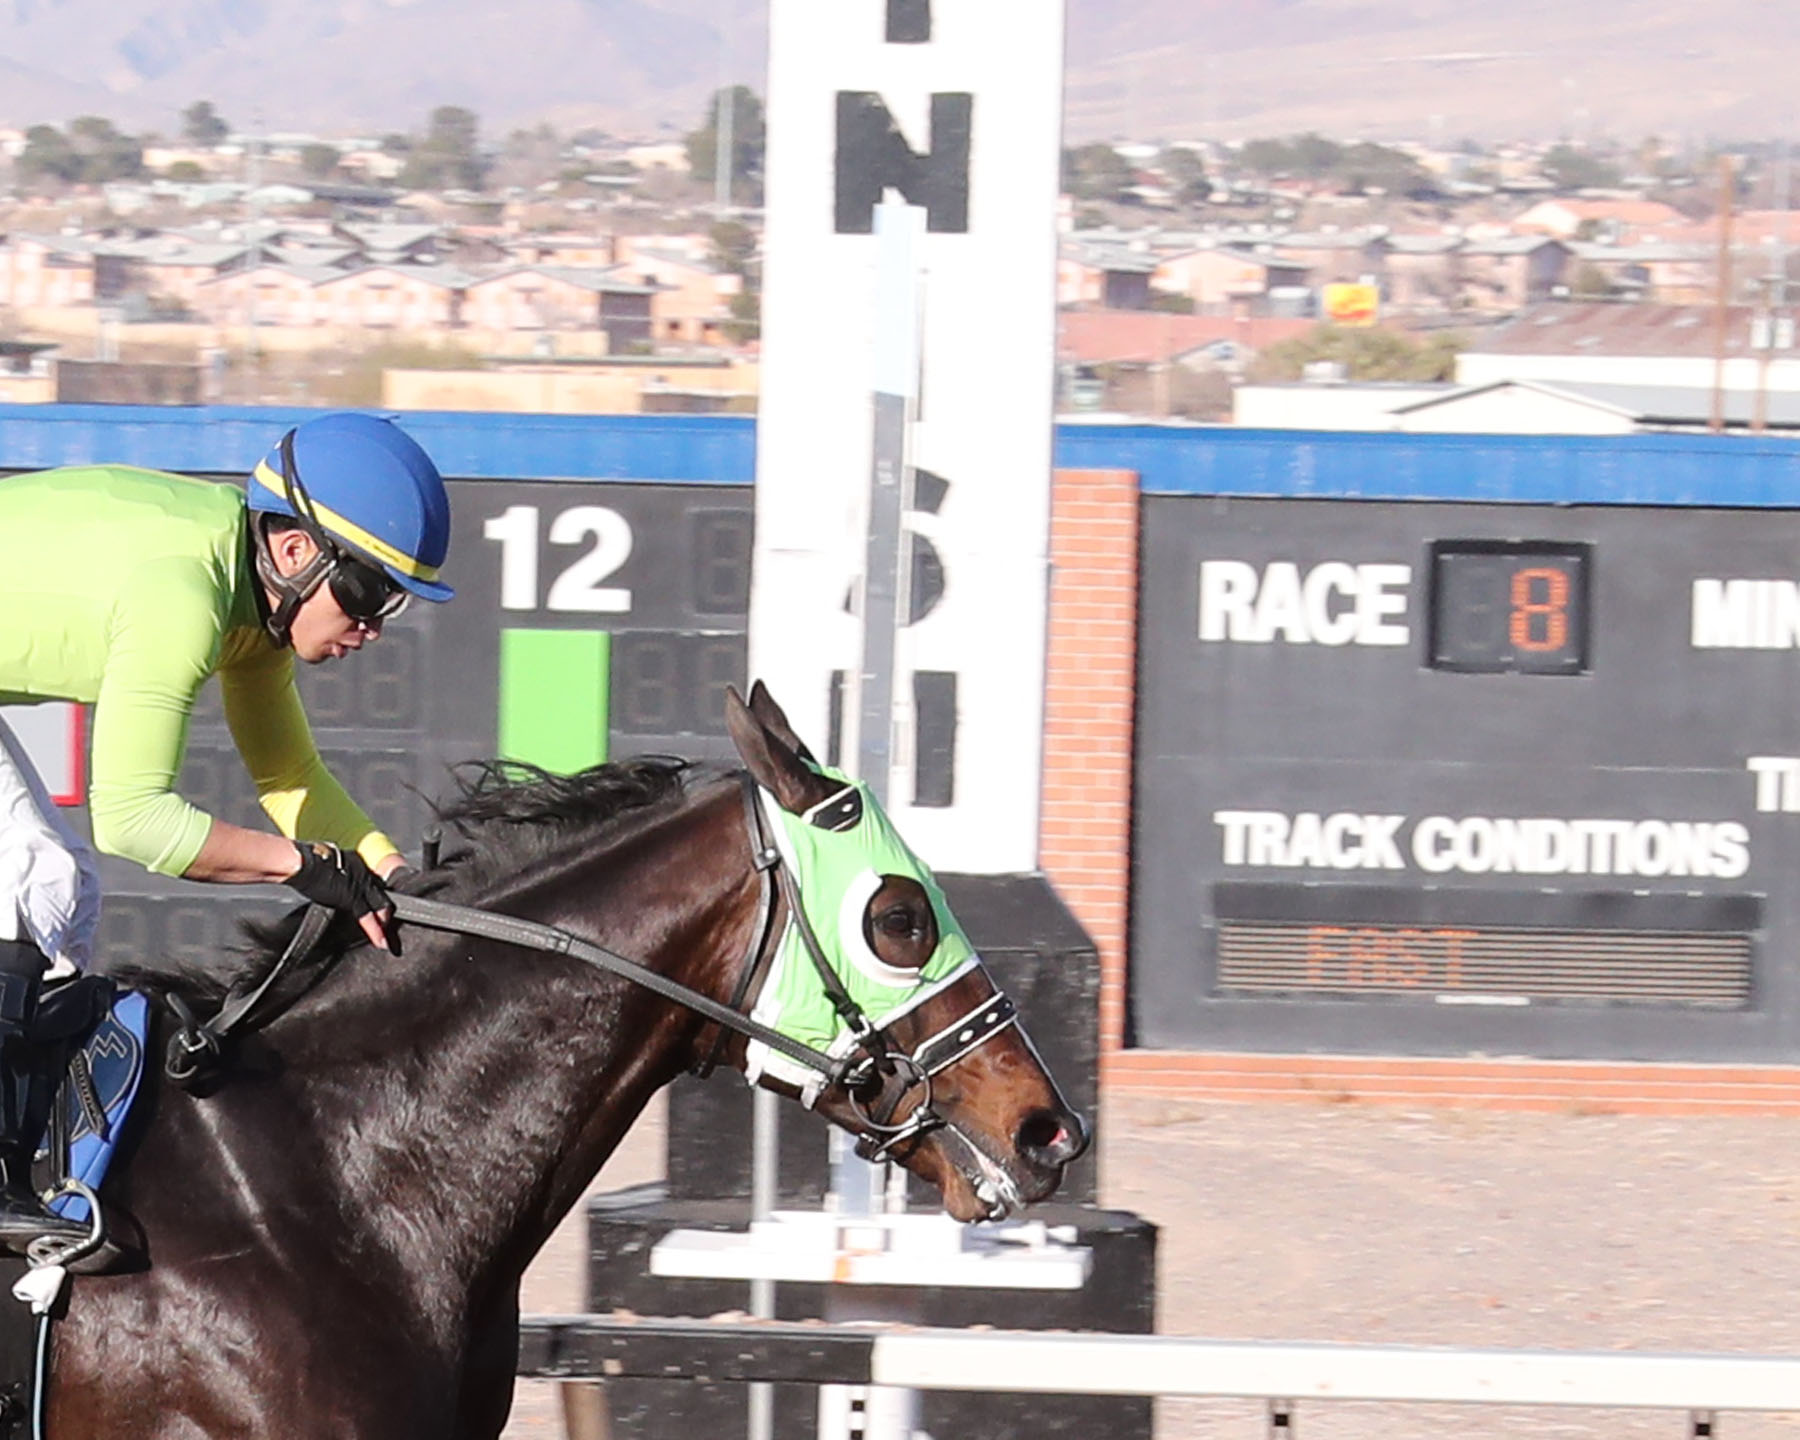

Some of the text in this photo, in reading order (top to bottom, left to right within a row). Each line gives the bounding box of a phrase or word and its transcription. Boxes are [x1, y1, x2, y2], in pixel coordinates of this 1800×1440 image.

[485, 506, 634, 613] 12
[1199, 561, 1412, 646] RACE
[1509, 567, 1569, 651] 8
[1214, 811, 1751, 879] TRACK CONDITIONS
[1306, 925, 1479, 987] FAST
